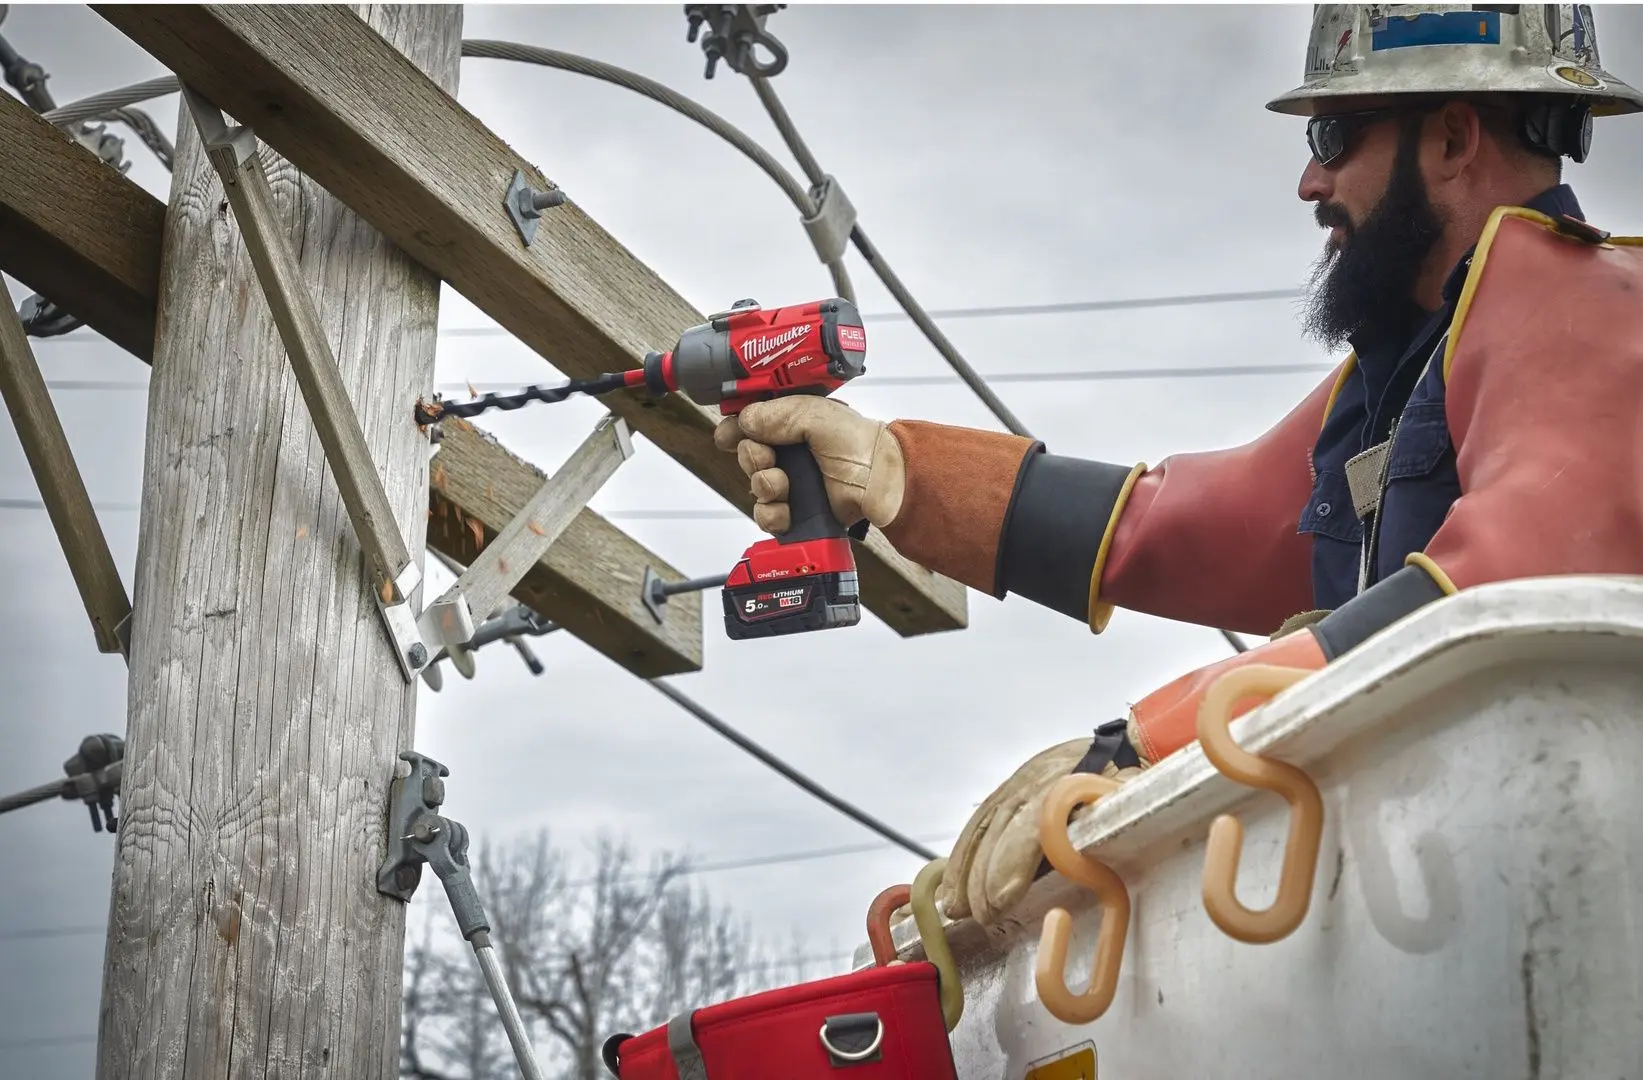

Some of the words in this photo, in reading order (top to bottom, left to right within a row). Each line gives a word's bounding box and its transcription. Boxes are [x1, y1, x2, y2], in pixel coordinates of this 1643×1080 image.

[841, 329, 864, 340] FUEL
[740, 324, 812, 361] Milwaukee
[787, 355, 813, 369] FUEL
[780, 596, 801, 607] M18
